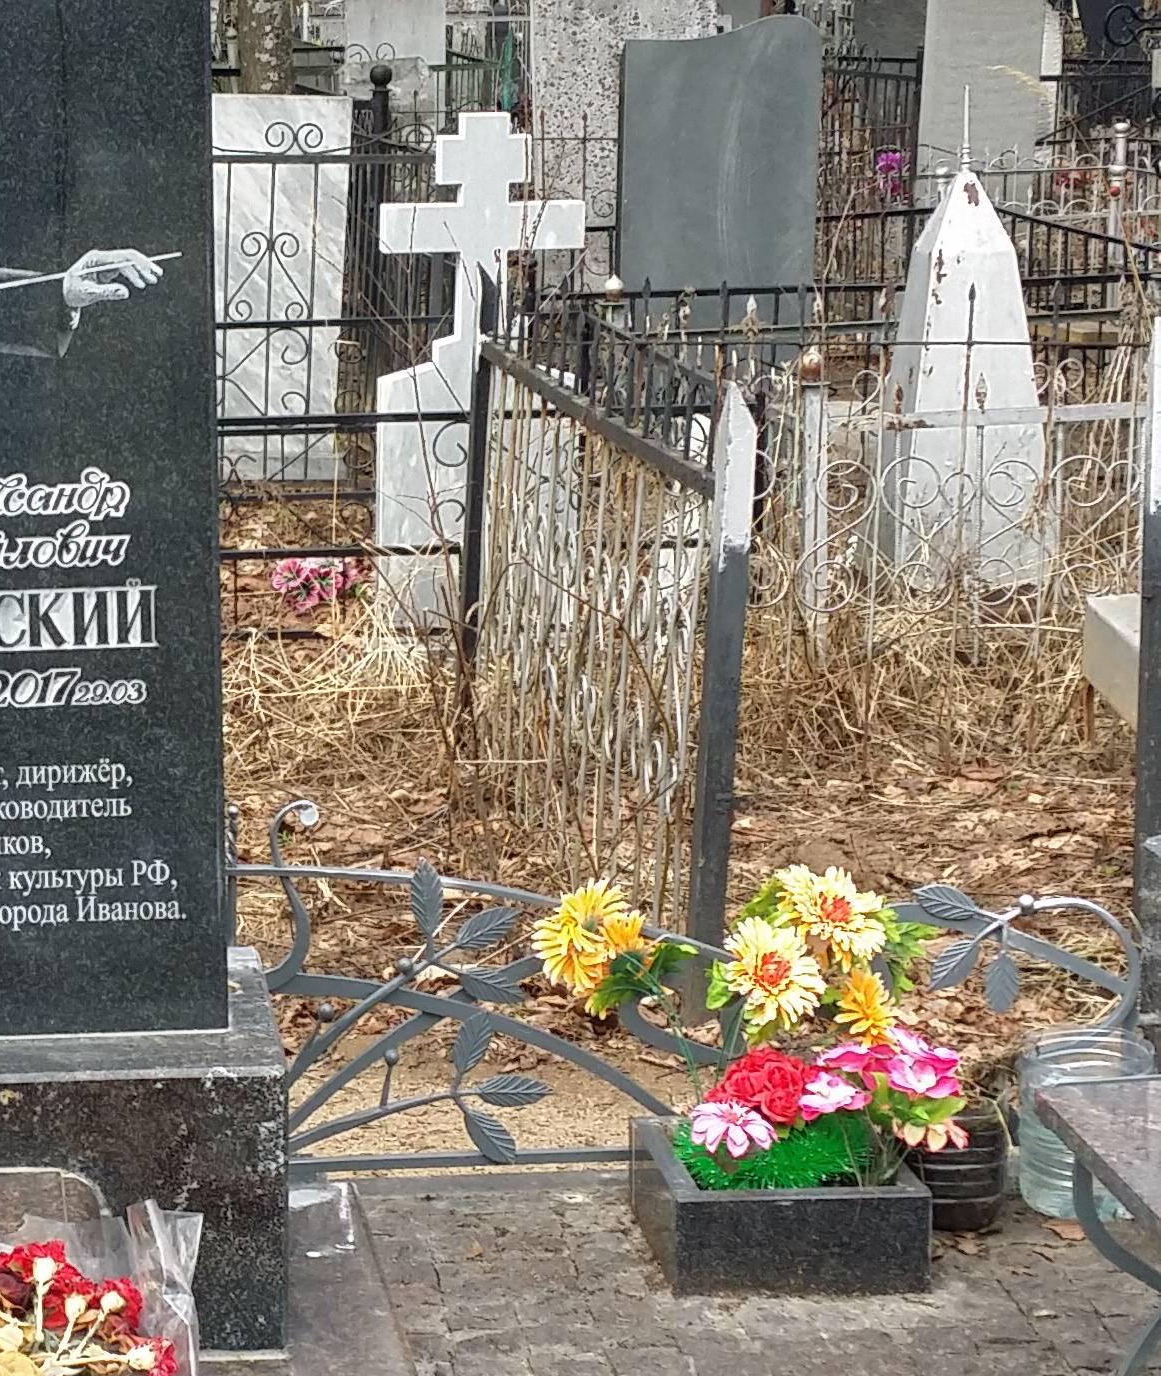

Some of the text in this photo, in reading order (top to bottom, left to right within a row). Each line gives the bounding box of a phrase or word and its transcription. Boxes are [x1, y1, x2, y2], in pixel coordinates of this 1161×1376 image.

[15, 758, 133, 791] дирижёр,
[8, 866, 124, 896] культуры
[131, 859, 178, 890] РФ,
[76, 894, 187, 923] Иванова.
